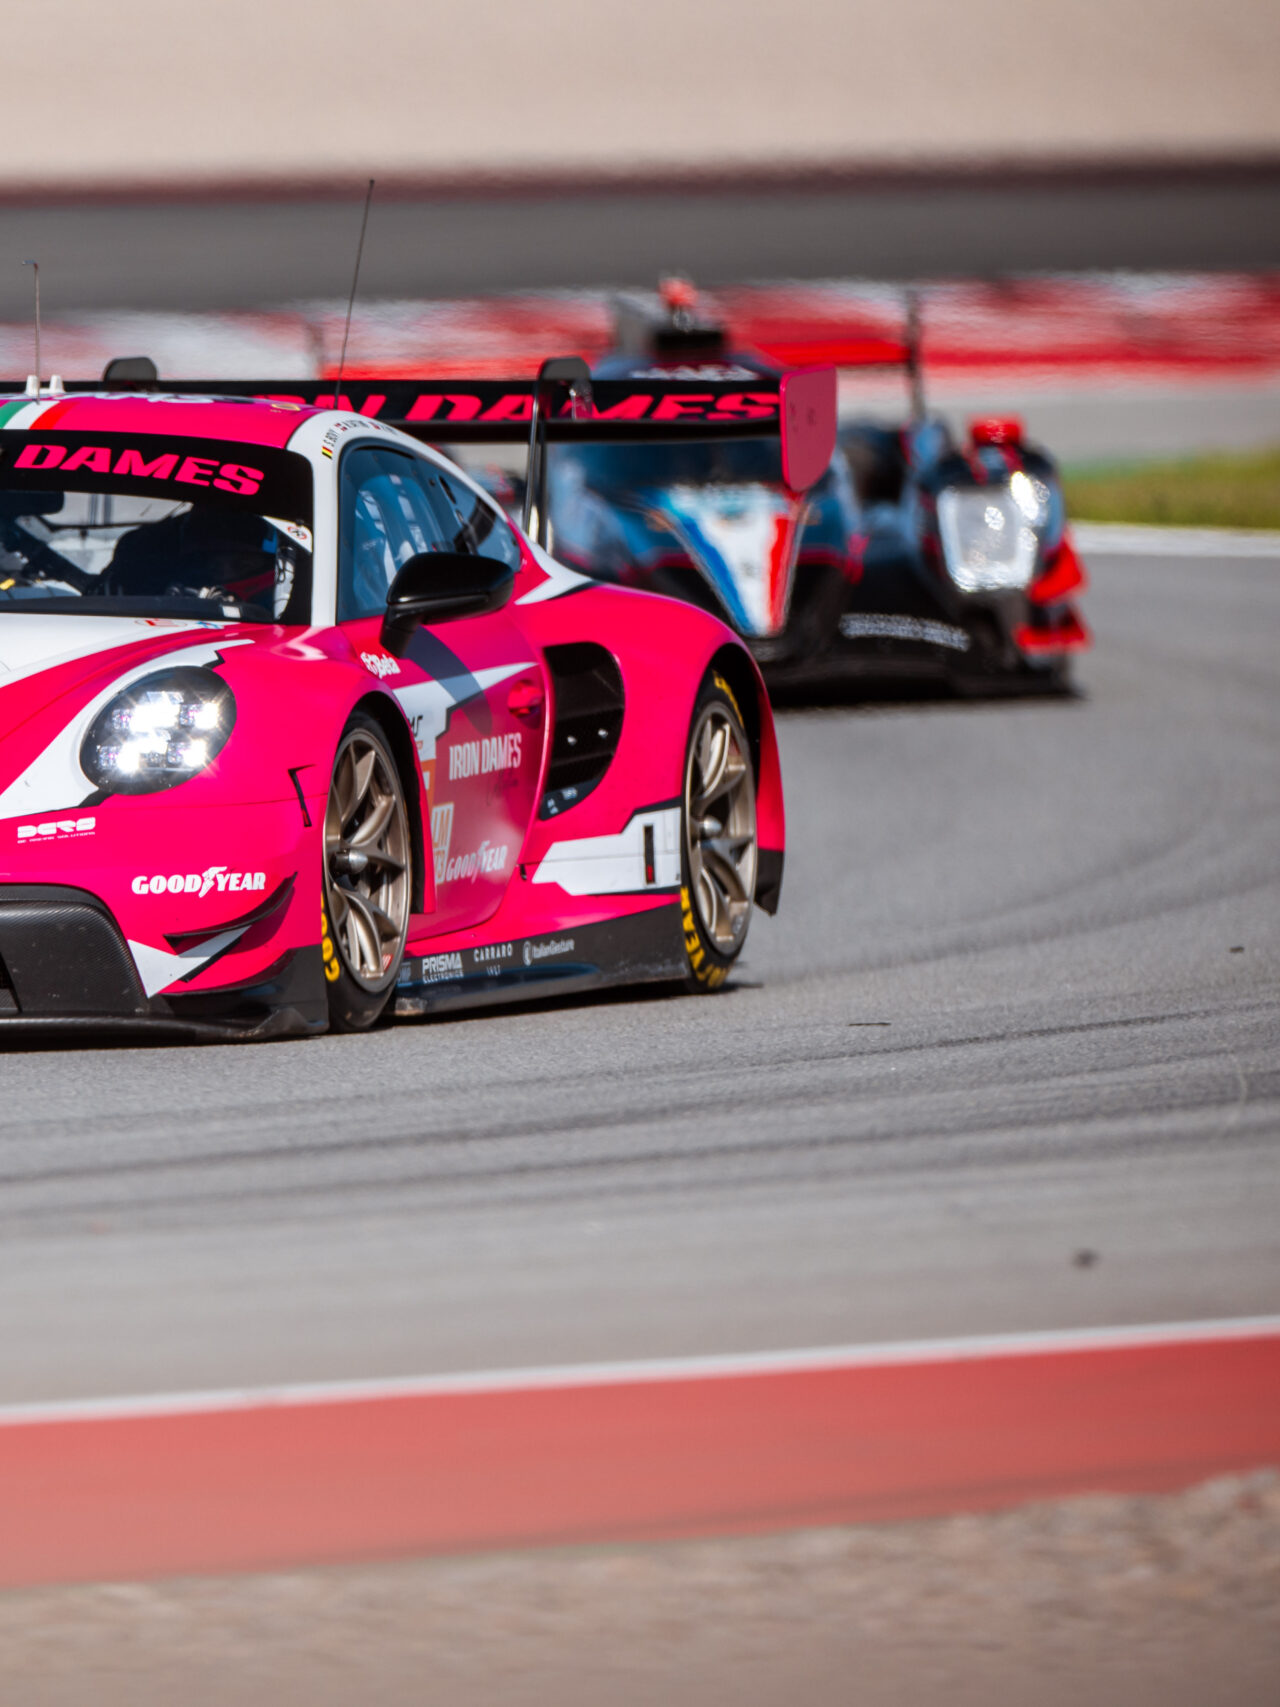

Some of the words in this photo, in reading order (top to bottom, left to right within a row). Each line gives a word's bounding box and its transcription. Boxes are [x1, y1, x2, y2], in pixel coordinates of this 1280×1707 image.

[14, 443, 265, 496] DAMES
[449, 741, 480, 781] IRON
[481, 732, 522, 774] DAMES
[446, 840, 508, 884] GOODYEAR
[132, 866, 266, 897] GOODYEAR
[422, 952, 463, 975] PRISMA
[474, 943, 513, 962] CARRARO
[423, 970, 464, 984] ELECTRONICS
